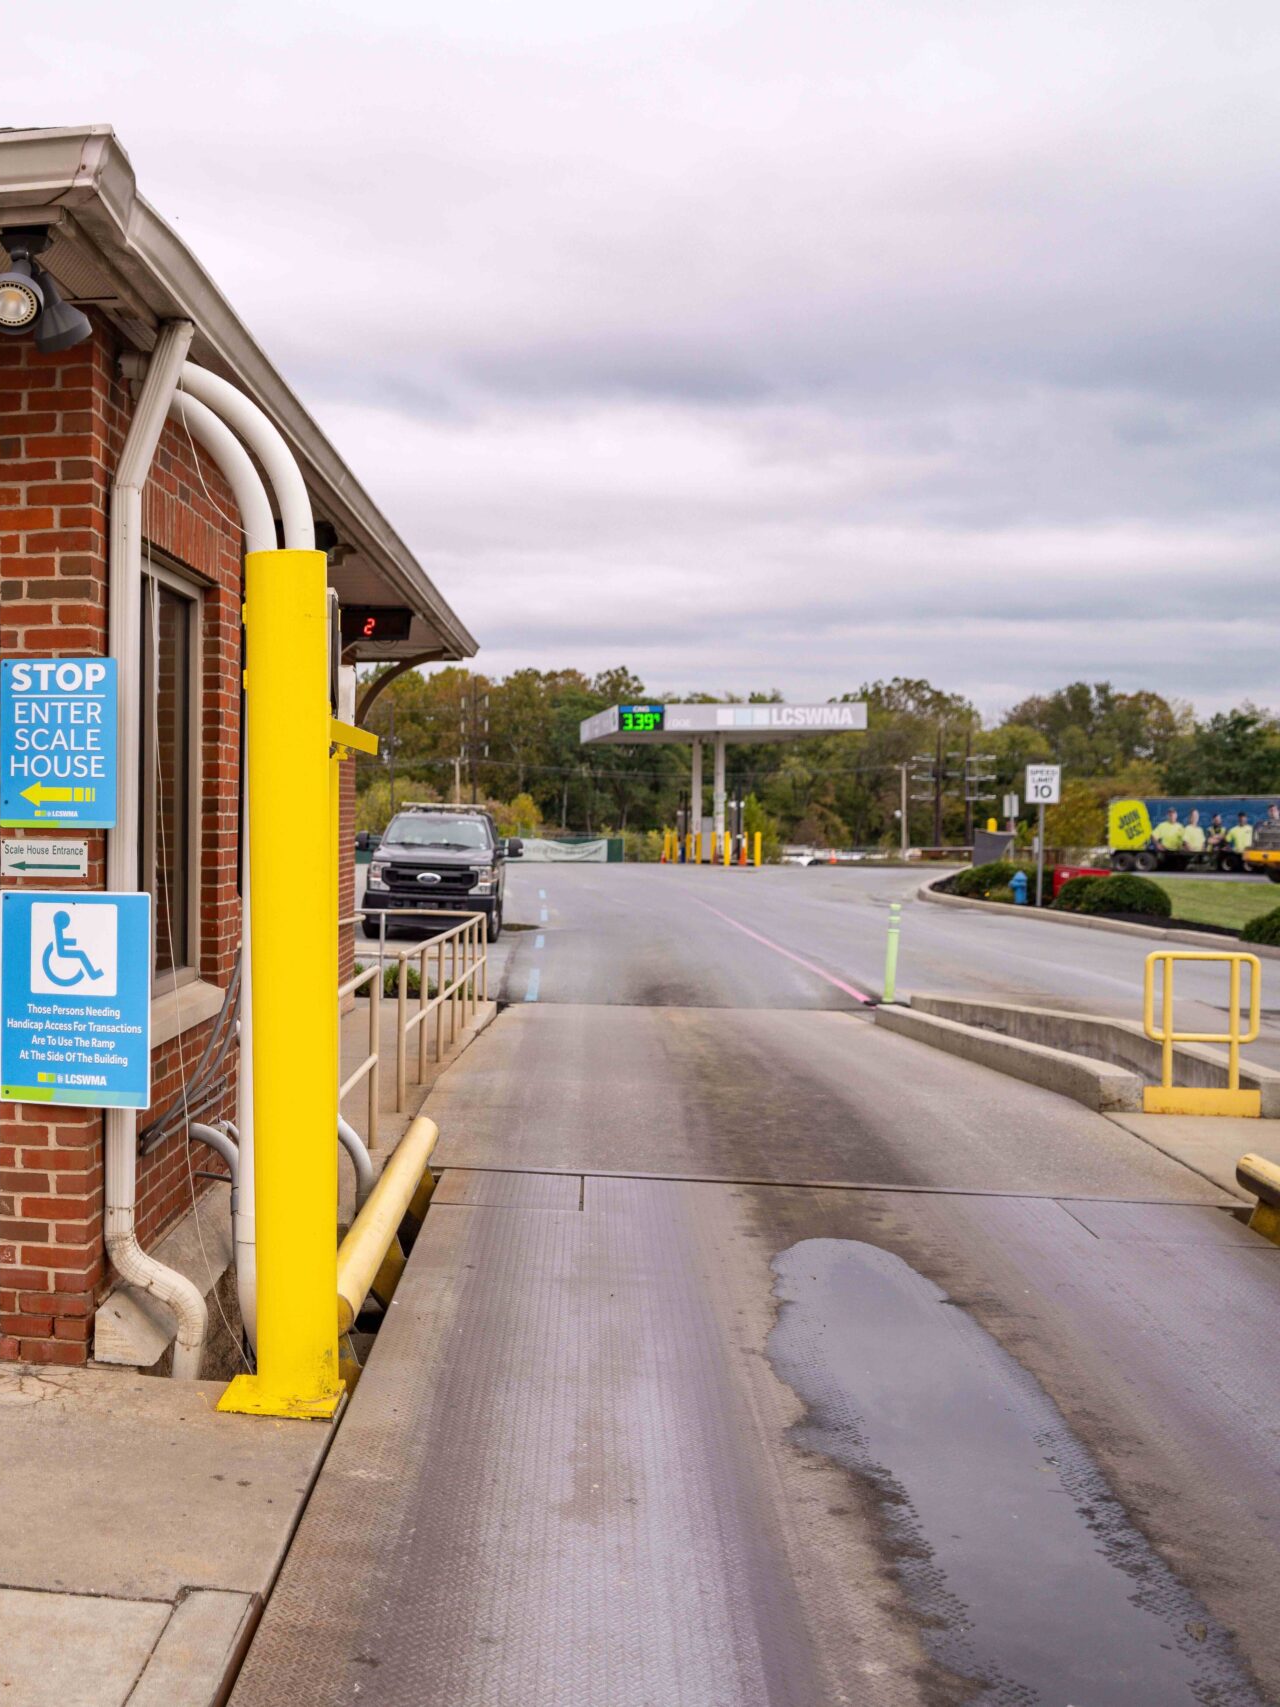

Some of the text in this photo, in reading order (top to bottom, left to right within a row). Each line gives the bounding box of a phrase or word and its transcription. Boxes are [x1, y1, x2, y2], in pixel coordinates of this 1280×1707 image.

[363, 617, 376, 635] 2
[10, 662, 106, 692] STOP
[14, 702, 102, 724] ENTER
[771, 707, 854, 725] LCSWMA
[14, 728, 101, 751] SCALE
[10, 755, 105, 778] HOUSE
[1034, 785, 1052, 799] 10
[51, 810, 78, 818] LCSWMA
[4, 843, 84, 856] Scale House Entrance
[27, 1003, 121, 1020] Those Persons Needing
[7, 1018, 142, 1034] Handicap Access For Transactions
[31, 1035, 115, 1049] Are To Use The Ramp
[19, 1049, 128, 1067] At The Side Of The Building
[65, 1074, 107, 1086] LCSWMA
